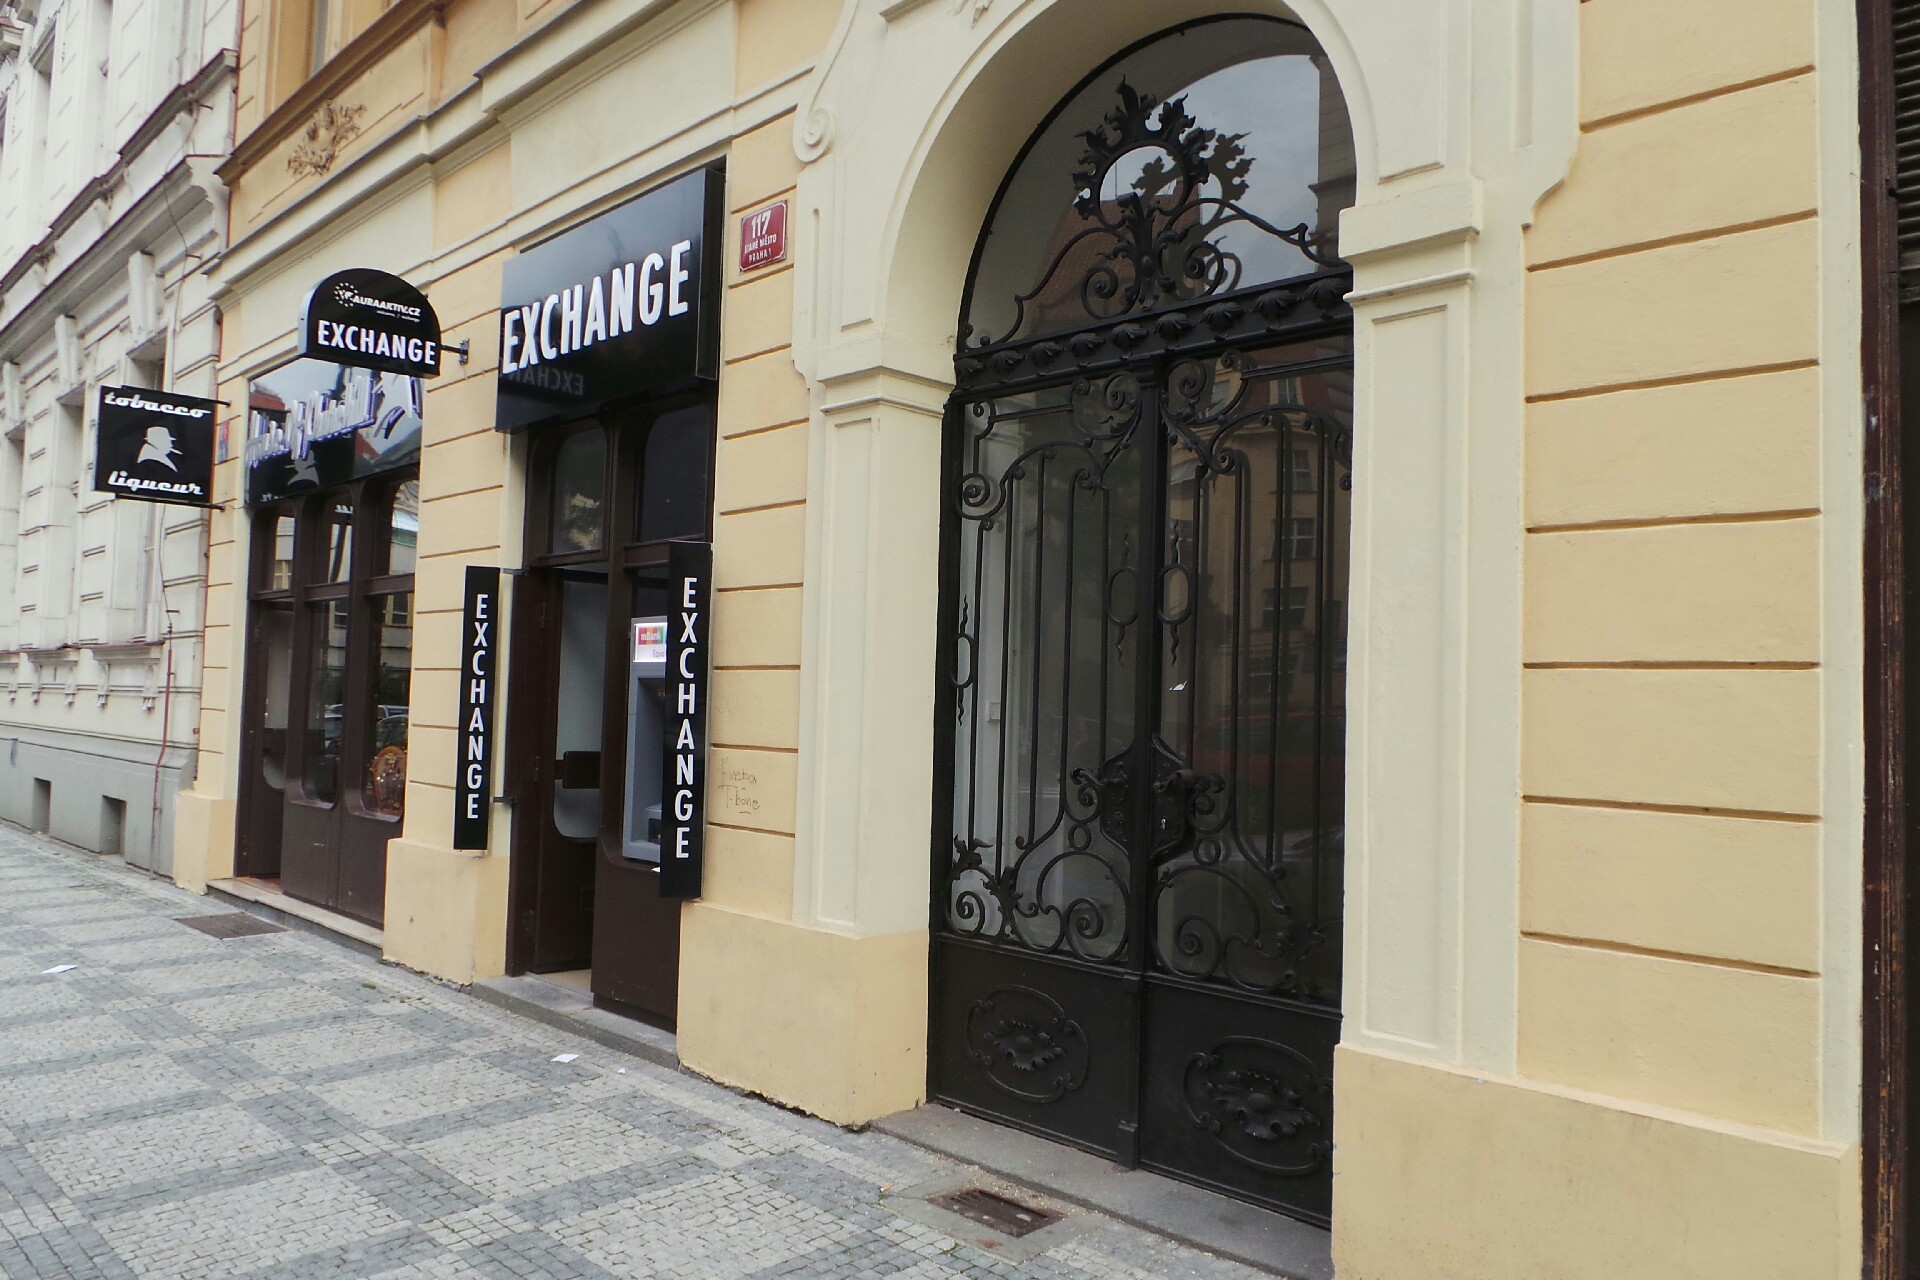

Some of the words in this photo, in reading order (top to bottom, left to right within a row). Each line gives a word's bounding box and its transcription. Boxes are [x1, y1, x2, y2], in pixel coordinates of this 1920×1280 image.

[752, 209, 772, 239] 117
[502, 239, 691, 374] EXCHANGE
[317, 319, 437, 365] EXCHANGE
[103, 391, 212, 418] tobacco
[107, 470, 204, 496] liqueur
[466, 594, 489, 819] EXCHANGE
[674, 577, 699, 858] EXCHANGE
